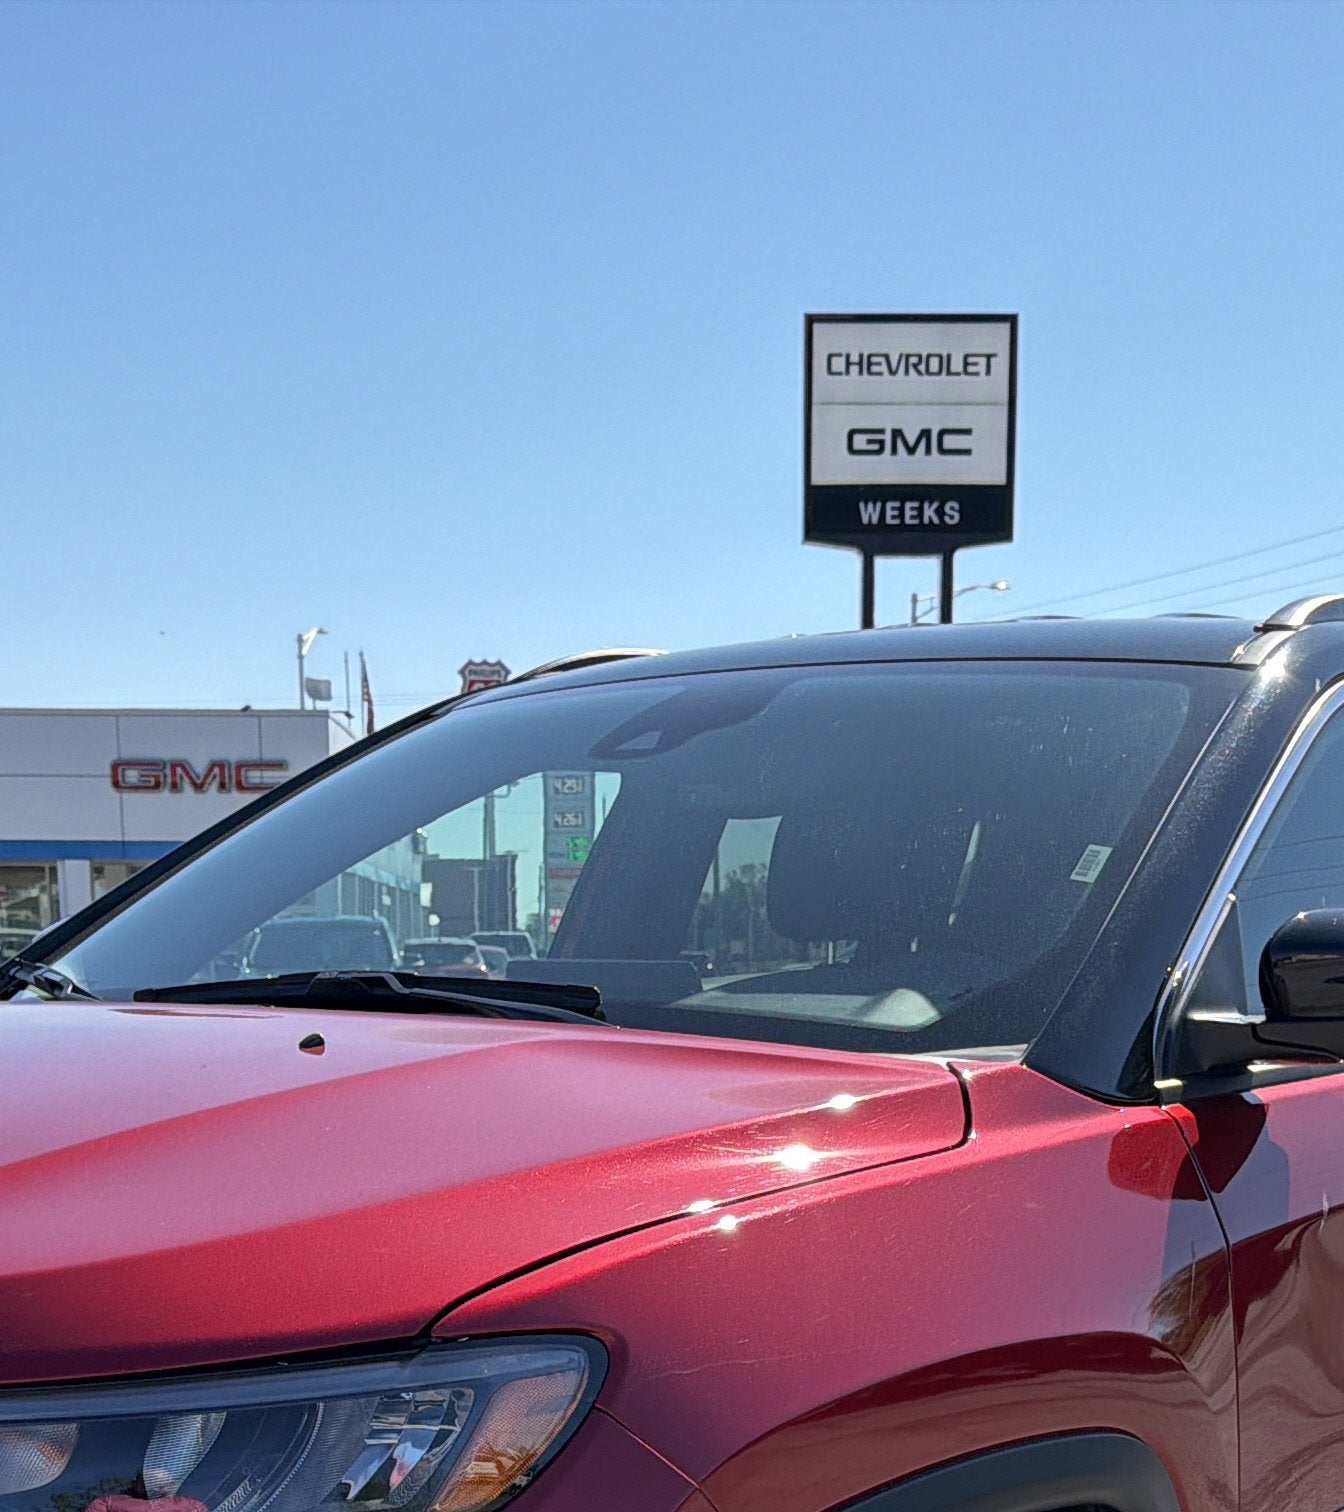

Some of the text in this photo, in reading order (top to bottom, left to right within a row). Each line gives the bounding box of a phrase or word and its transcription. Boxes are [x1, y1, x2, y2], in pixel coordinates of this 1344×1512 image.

[825, 352, 998, 377] CHEVROLET
[846, 427, 973, 456] GMC
[858, 500, 961, 525] WEEKS
[111, 760, 288, 793] GMC
